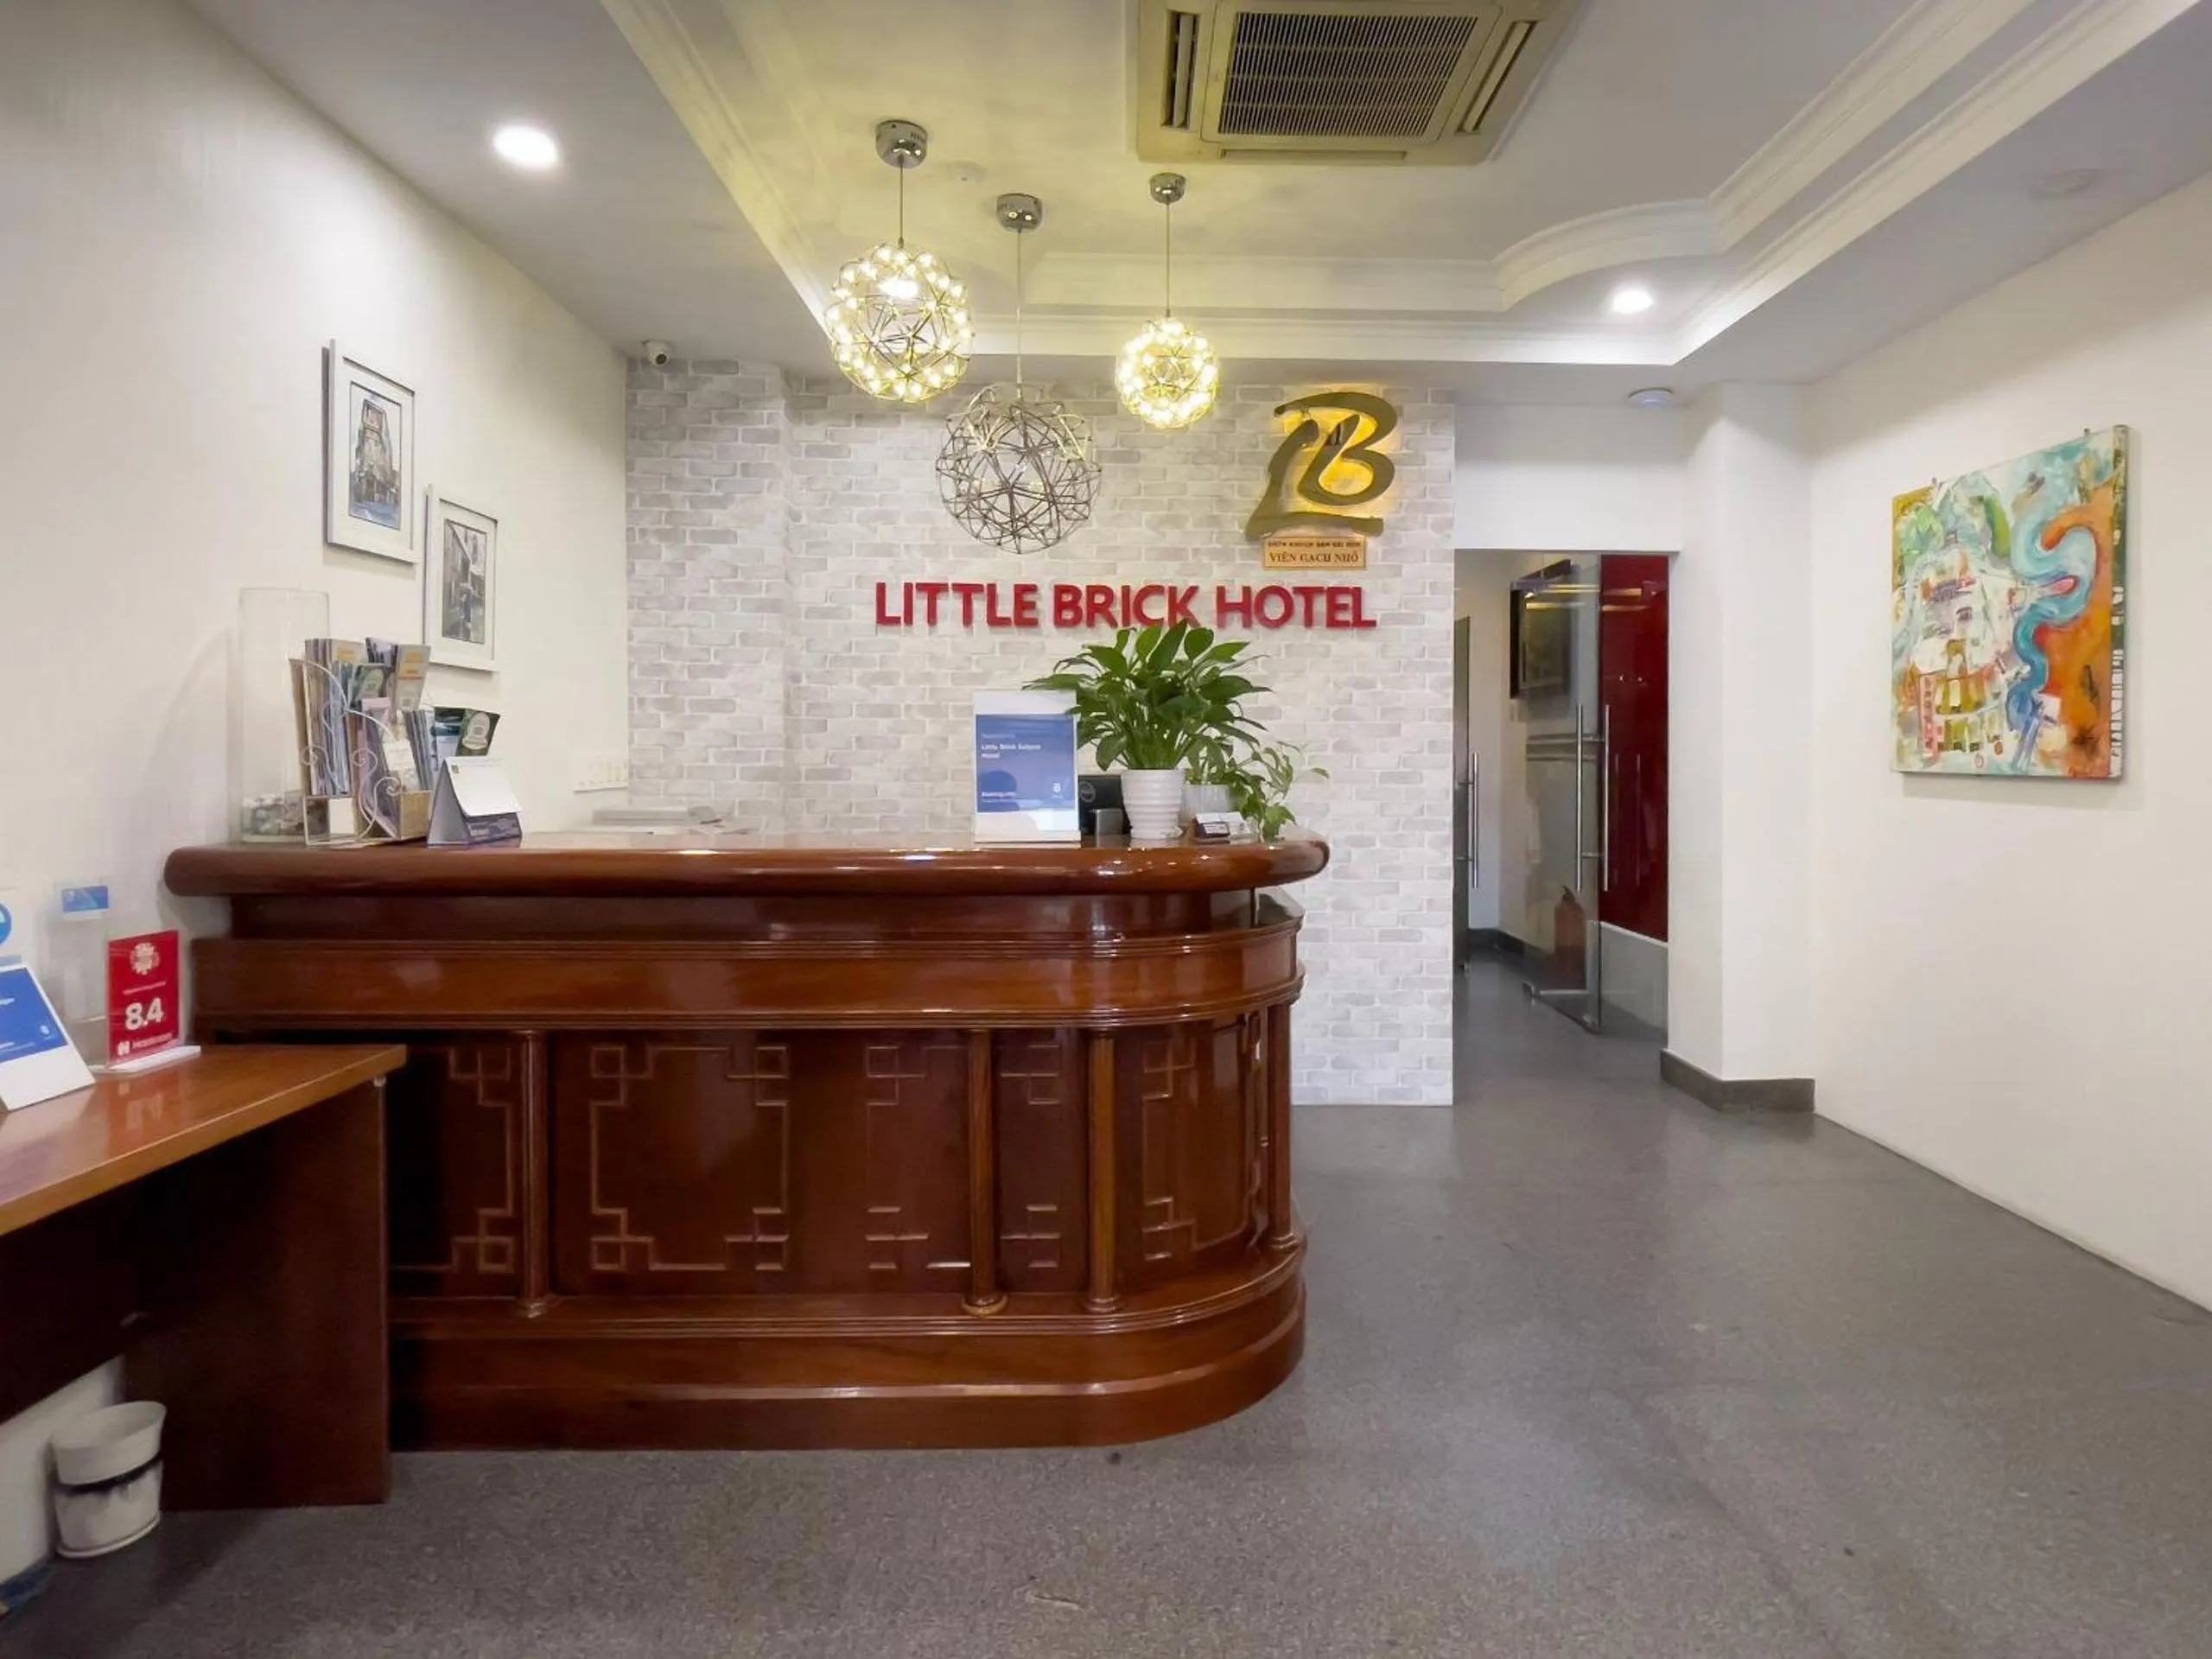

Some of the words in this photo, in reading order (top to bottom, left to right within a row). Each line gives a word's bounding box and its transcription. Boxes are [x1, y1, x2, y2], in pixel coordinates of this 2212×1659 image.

[875, 582, 1039, 627] LITTLE
[1052, 583, 1202, 630] BRICK
[1215, 584, 1377, 630] HOTEL
[124, 996, 164, 1031] 8.4
